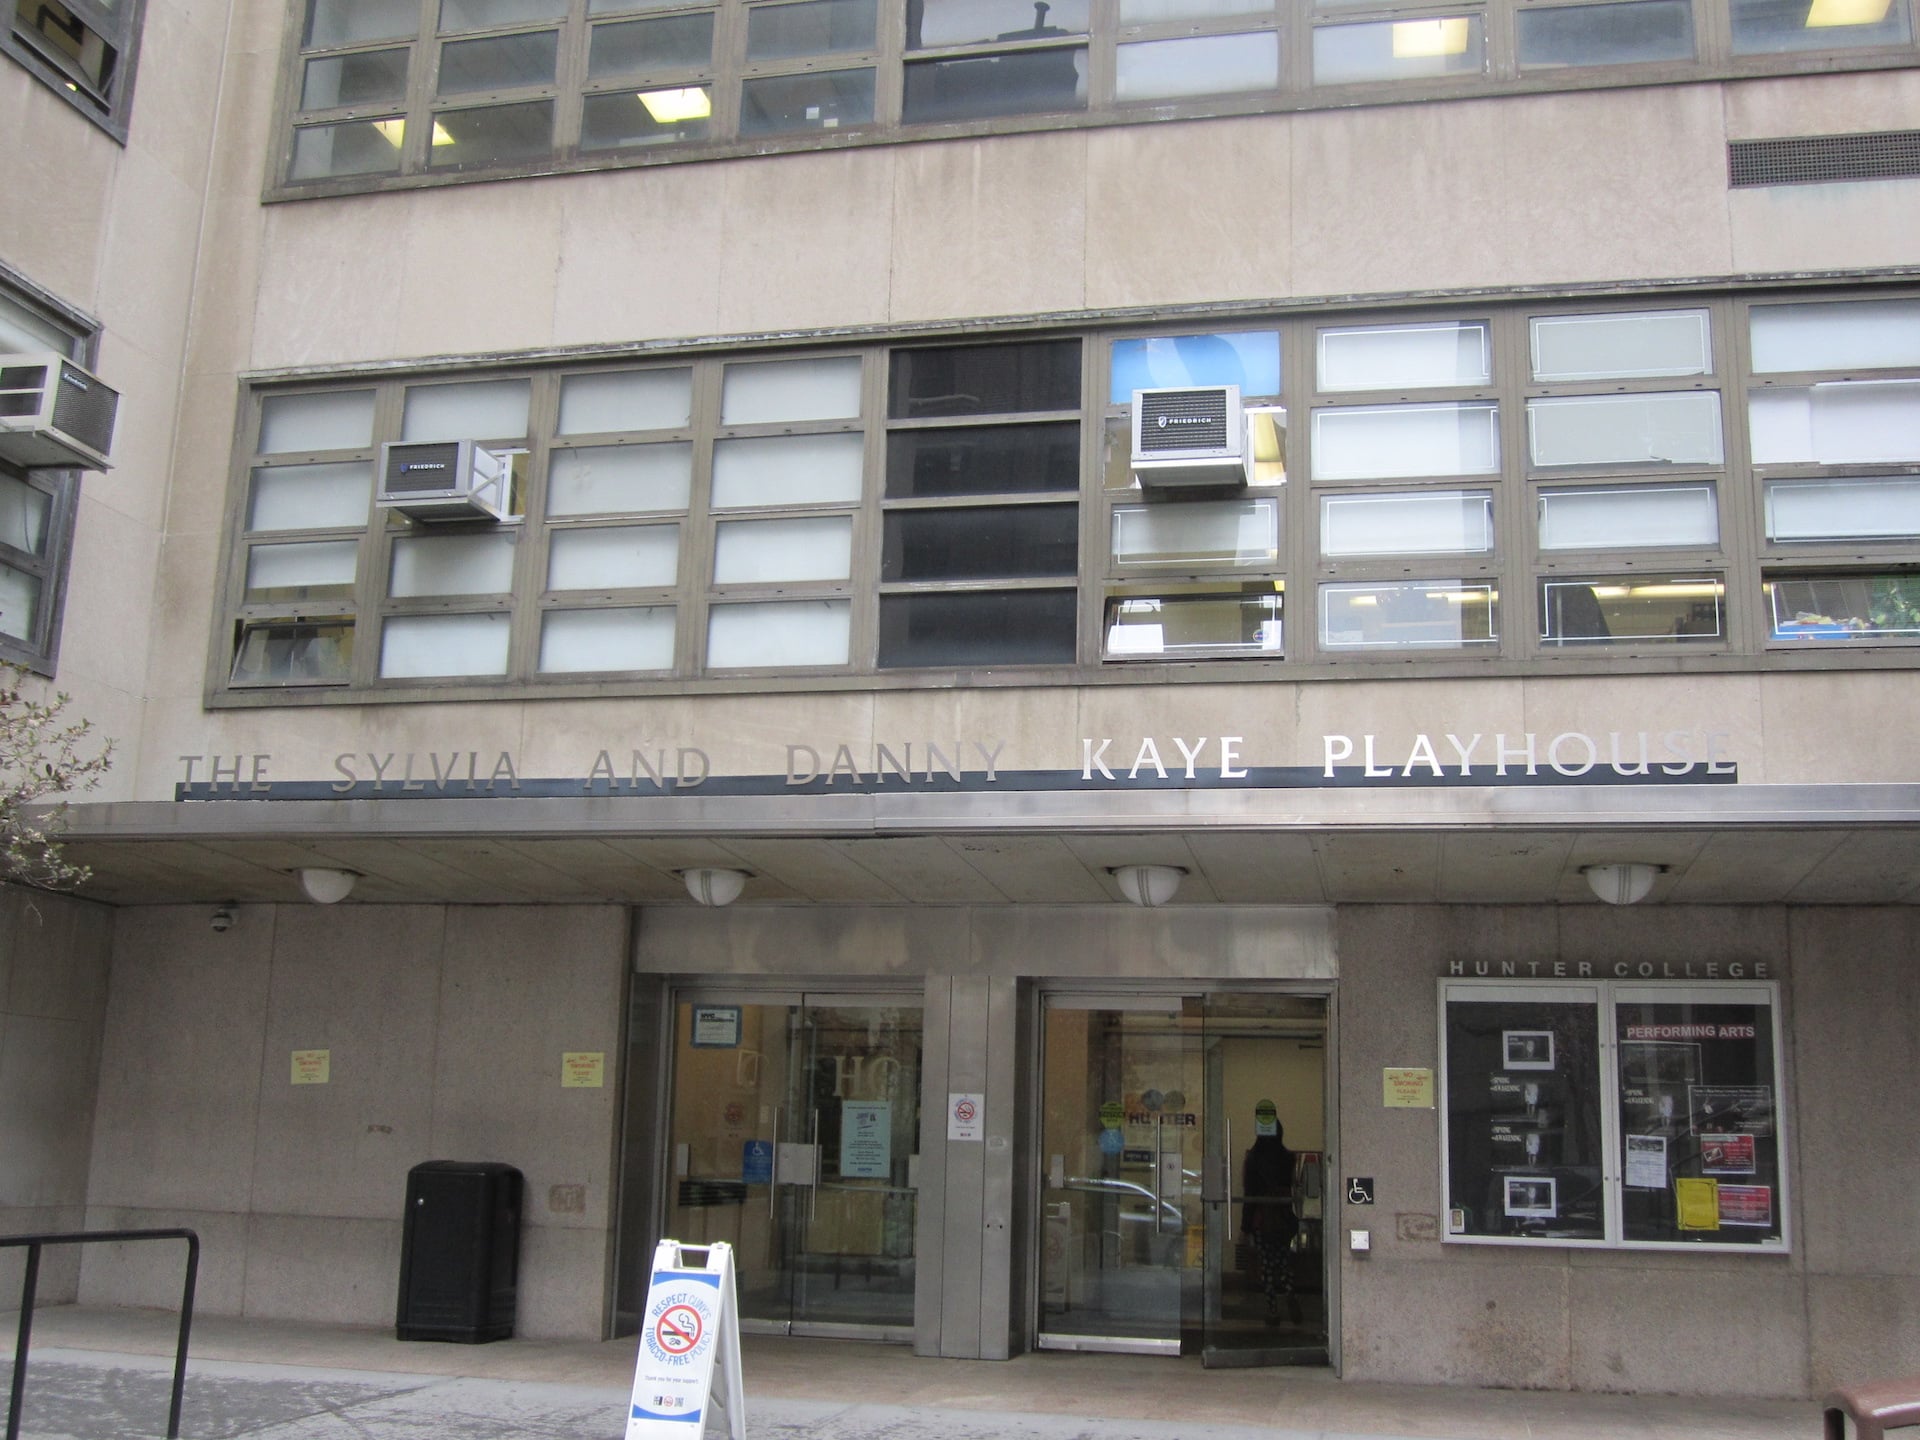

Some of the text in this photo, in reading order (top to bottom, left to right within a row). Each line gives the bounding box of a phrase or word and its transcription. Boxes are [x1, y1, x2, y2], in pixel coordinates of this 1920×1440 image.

[179, 731, 1738, 793] THE SYLVIA AND DANNY KAYE PLAYHOUSE
[1450, 961, 1768, 977] HUNTER COLLEGE
[1626, 1026, 1755, 1038] PERFORMING ARTS
[651, 1293, 688, 1317] RESPECT
[645, 1327, 713, 1366] TOBACCO-FREE POLICY
